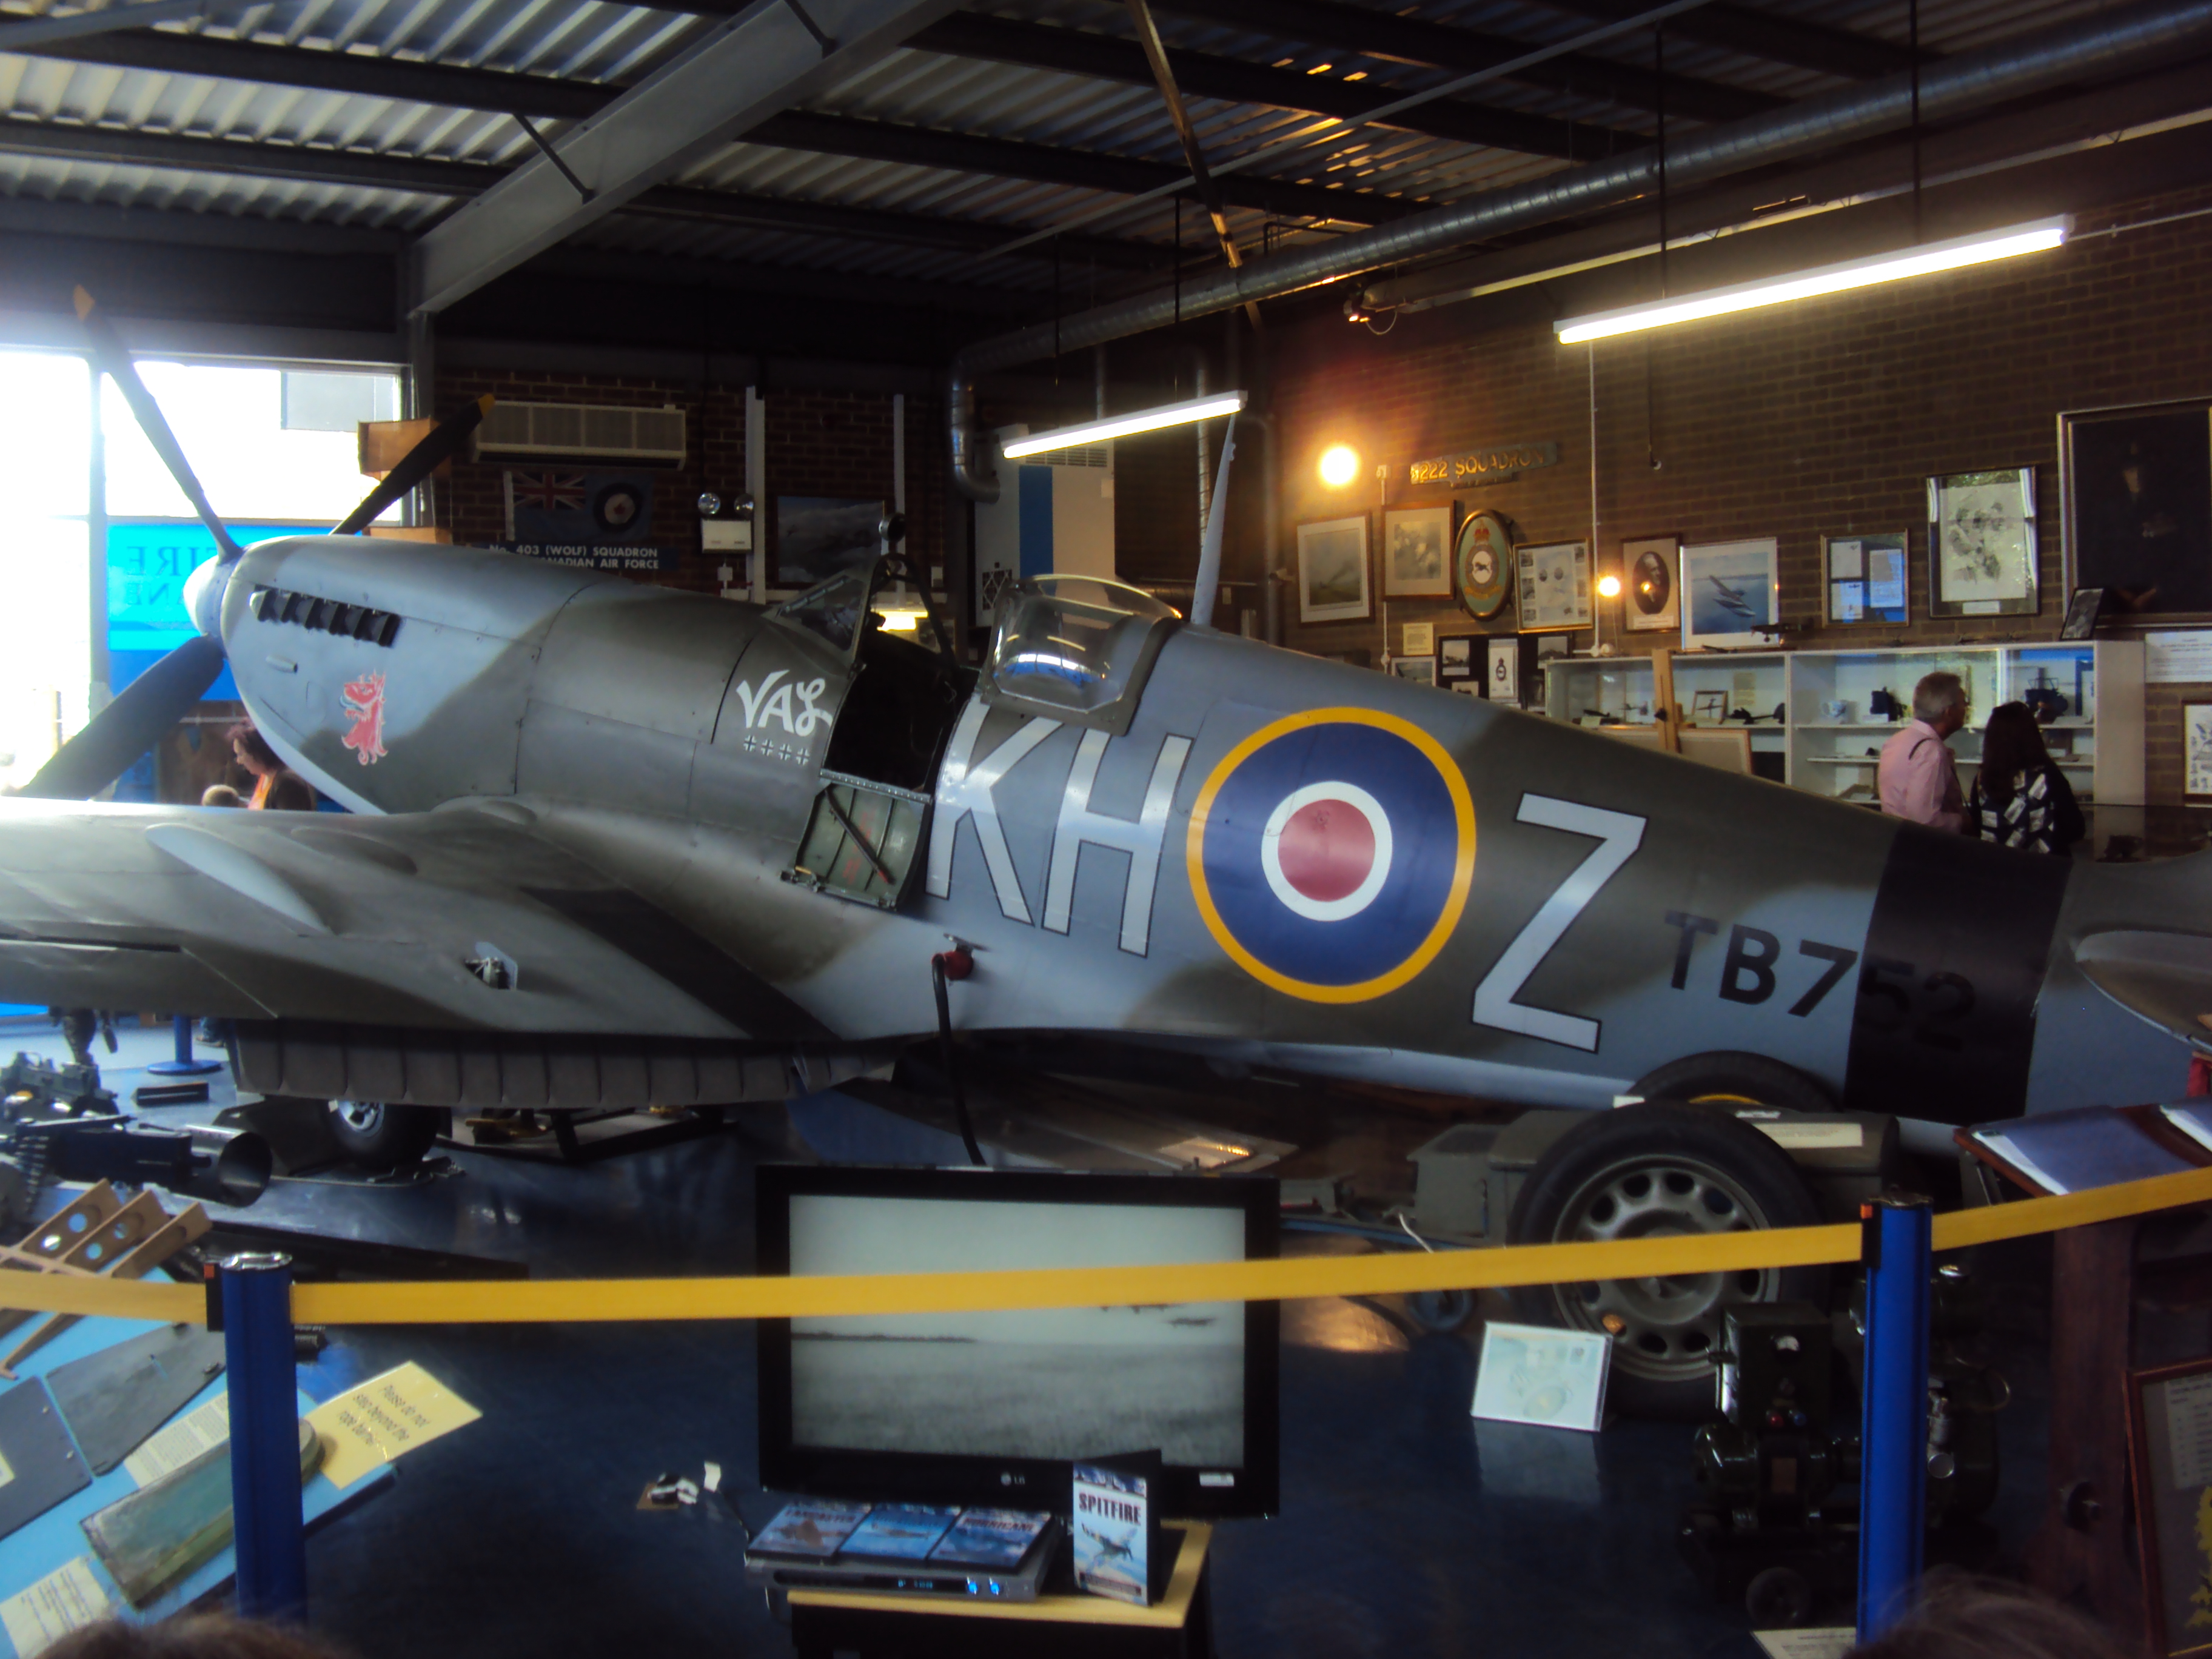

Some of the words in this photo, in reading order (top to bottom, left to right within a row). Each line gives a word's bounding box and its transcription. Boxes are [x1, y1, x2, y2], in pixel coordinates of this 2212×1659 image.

[1455, 447, 1544, 476] SQUADRON
[516, 545, 539, 555] 403
[546, 545, 586, 557] (WOLF)
[593, 547, 657, 557] SQUADRON
[600, 559, 618, 568] AIR
[625, 559, 659, 569] FORCE
[736, 669, 833, 737] VAL
[925, 692, 1195, 958] KH
[1472, 791, 1649, 1054] Z
[1664, 910, 1976, 1053] TB752
[1078, 1492, 1141, 1526] SPITFIRE
